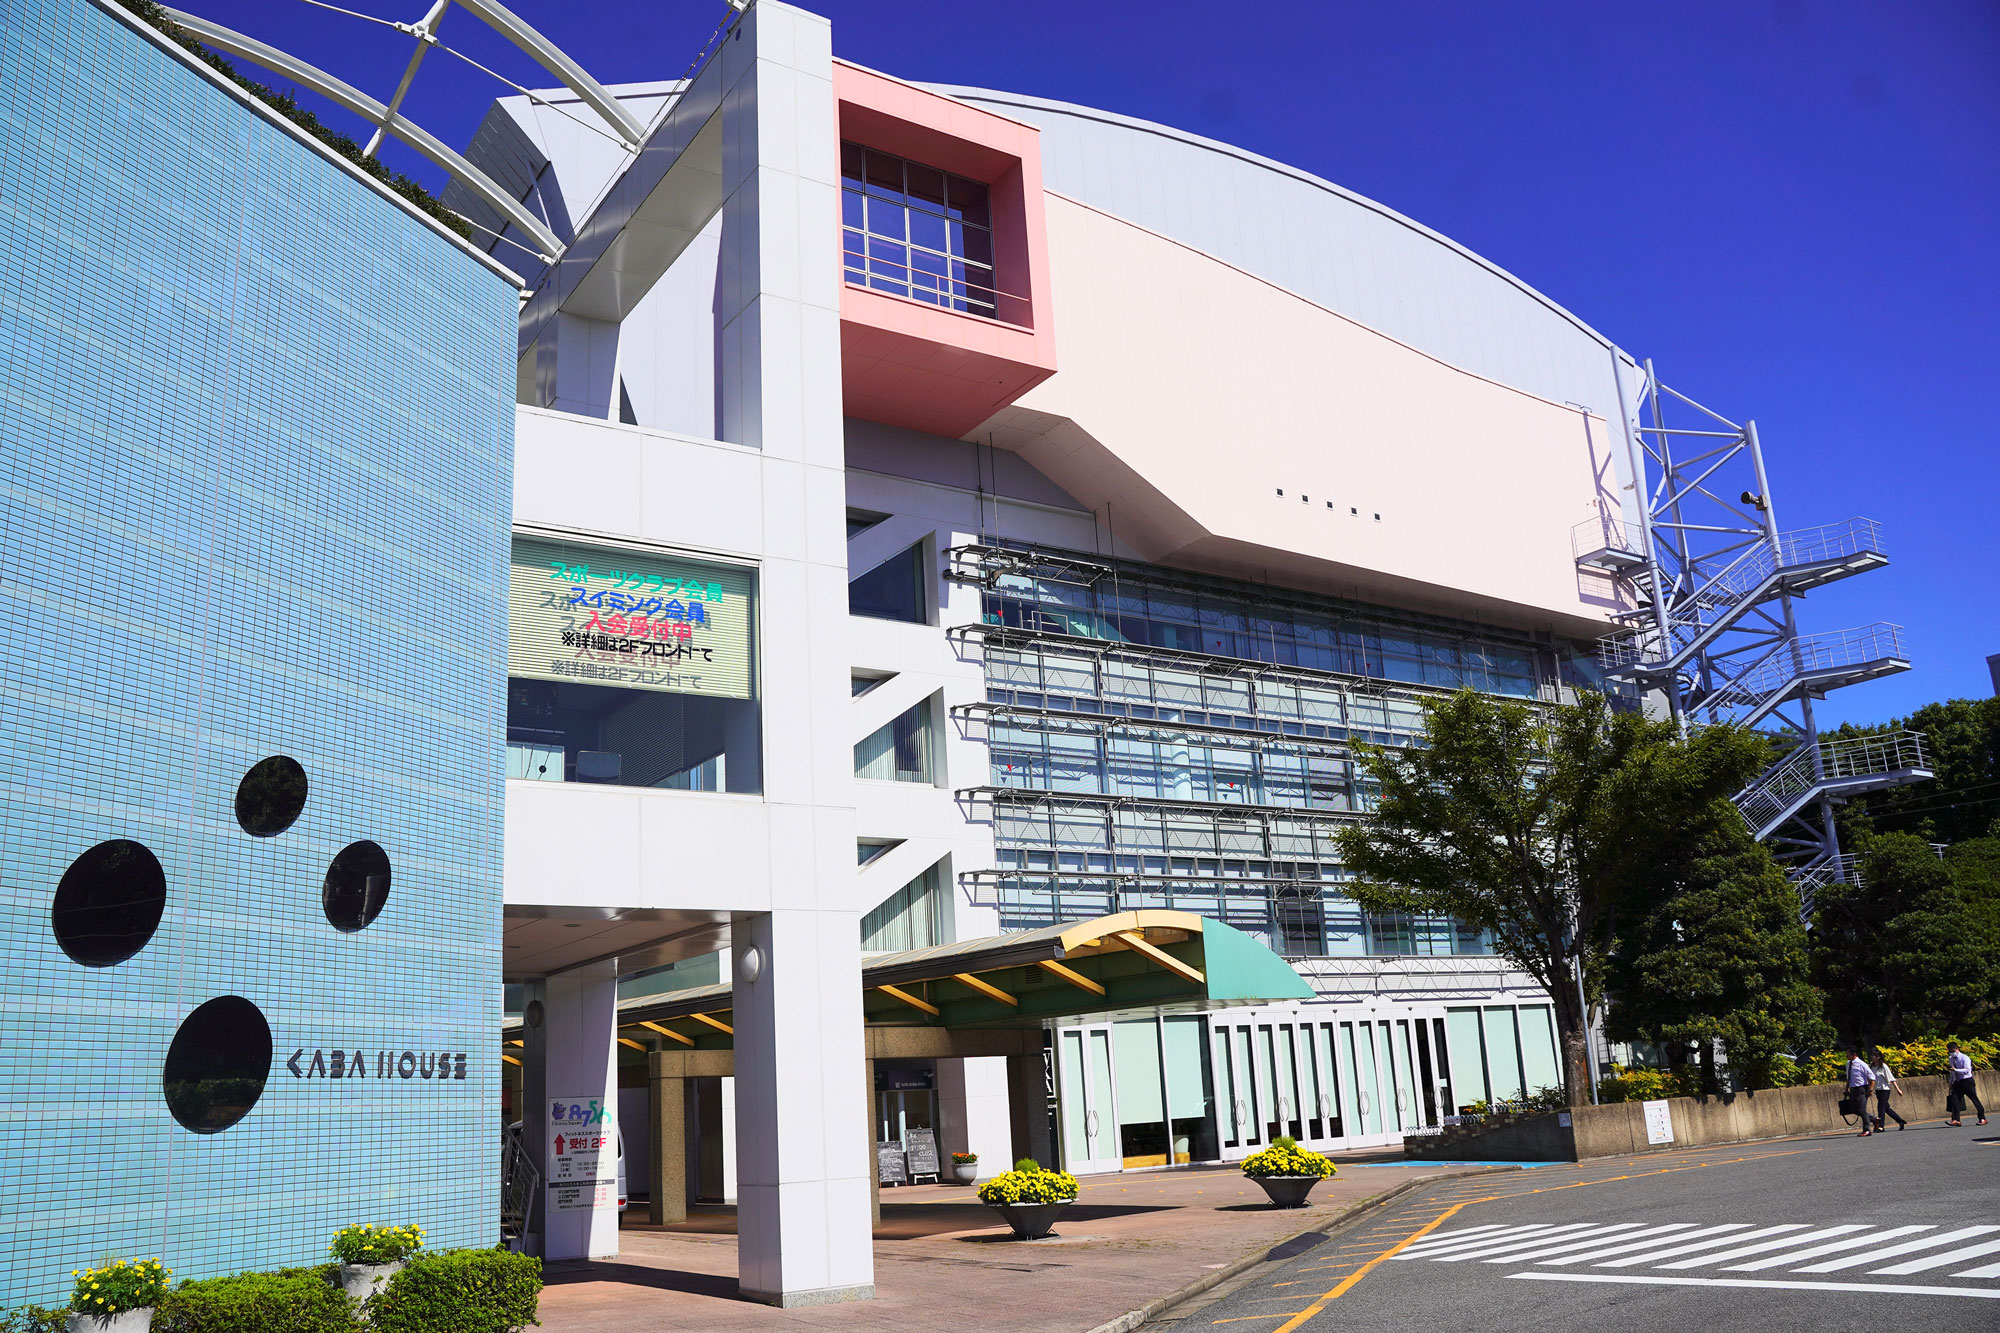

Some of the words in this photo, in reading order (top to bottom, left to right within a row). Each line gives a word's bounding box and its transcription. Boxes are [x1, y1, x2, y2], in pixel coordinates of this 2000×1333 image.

[550, 561, 723, 603] スポーツクラブ会員
[569, 587, 705, 623] スイミング会員
[585, 610, 692, 642] 入会受付中
[287, 1049, 366, 1079] KABA
[377, 1051, 467, 1080] HOUSE
[569, 1138, 588, 1150] 受付
[591, 1137, 607, 1149] 2F
